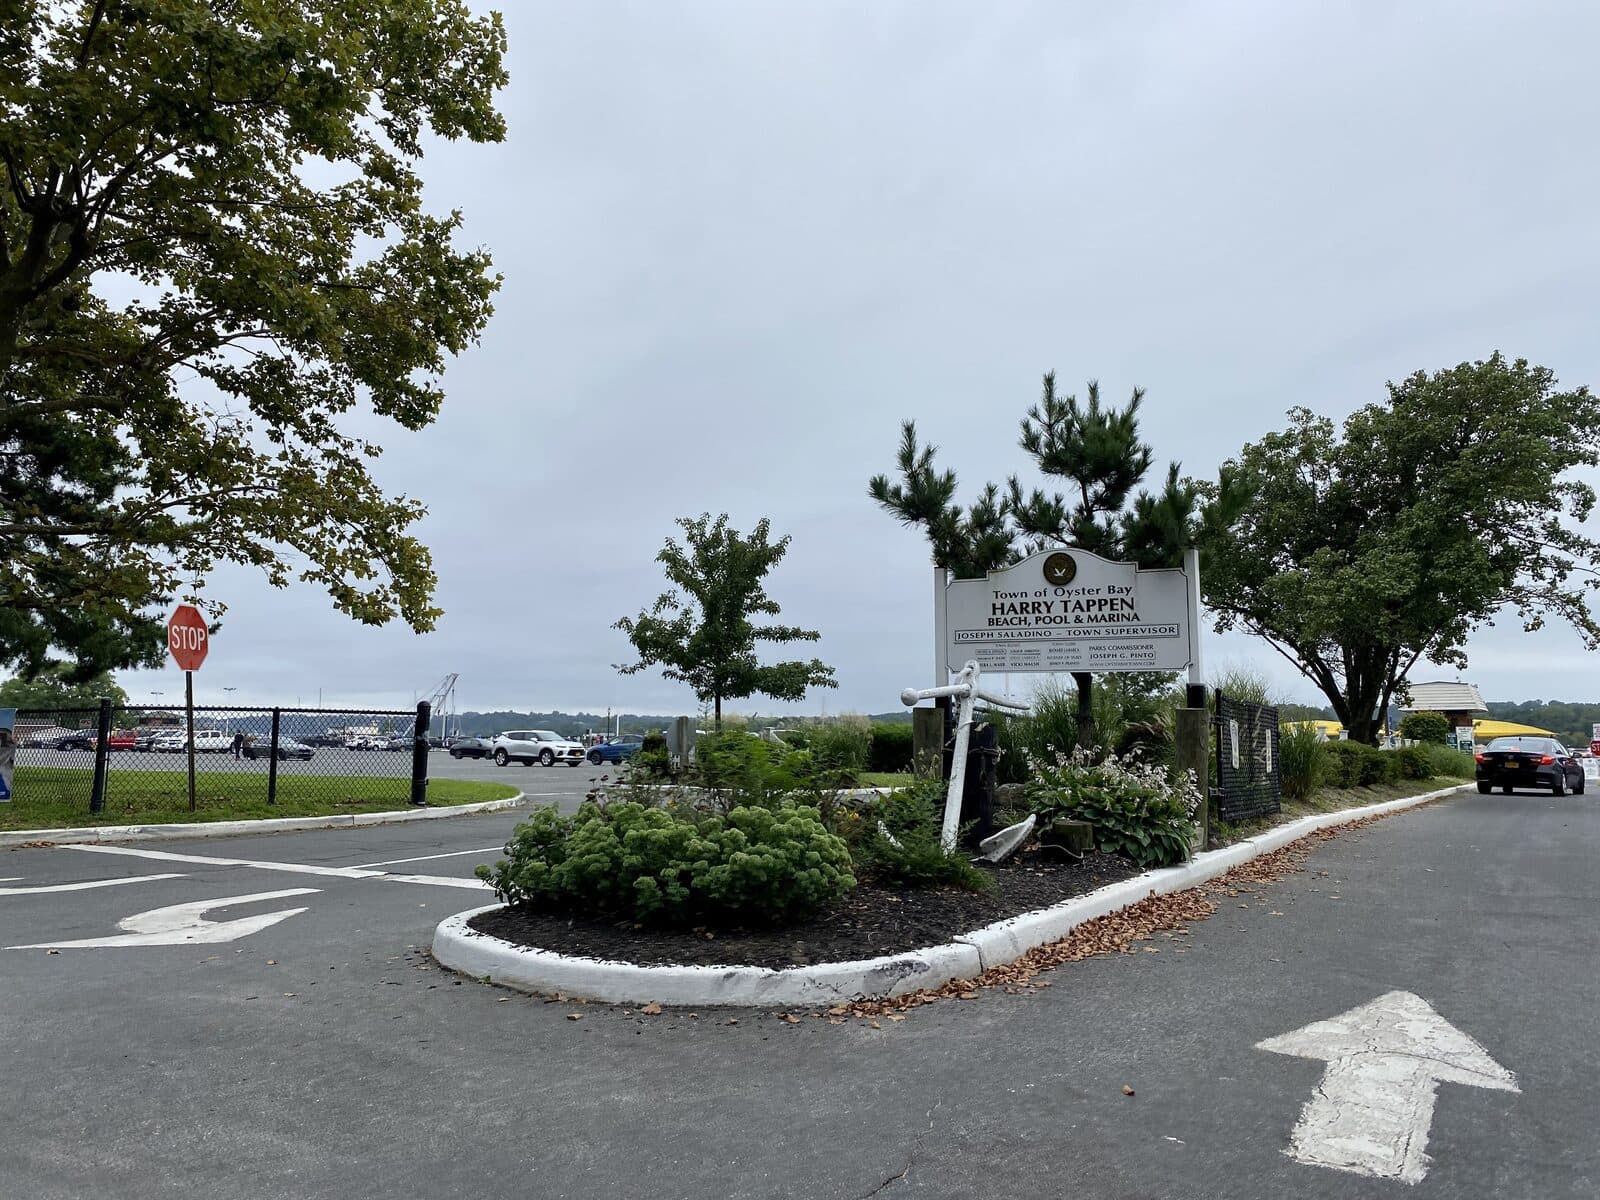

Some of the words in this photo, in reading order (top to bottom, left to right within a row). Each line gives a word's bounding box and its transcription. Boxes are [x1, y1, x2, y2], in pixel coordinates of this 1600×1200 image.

[993, 590, 1028, 600] Town
[1034, 588, 1047, 598] of
[1054, 587, 1101, 598] Oyster
[1108, 585, 1132, 596] Bay
[992, 601, 1054, 616] HARRY
[1060, 597, 1134, 613] TAPPEN
[988, 616, 1031, 627] BEACH,
[1035, 614, 1070, 625] POOL
[1074, 615, 1083, 624] &
[1087, 613, 1140, 623] MARINA
[171, 624, 206, 651] STOP
[957, 632, 994, 640] JOSEPH
[998, 630, 1052, 638] SALADINO
[1067, 628, 1101, 637] TOWN
[1105, 626, 1176, 636] SUPERVISOR
[1592, 743, 1600, 752] ST
